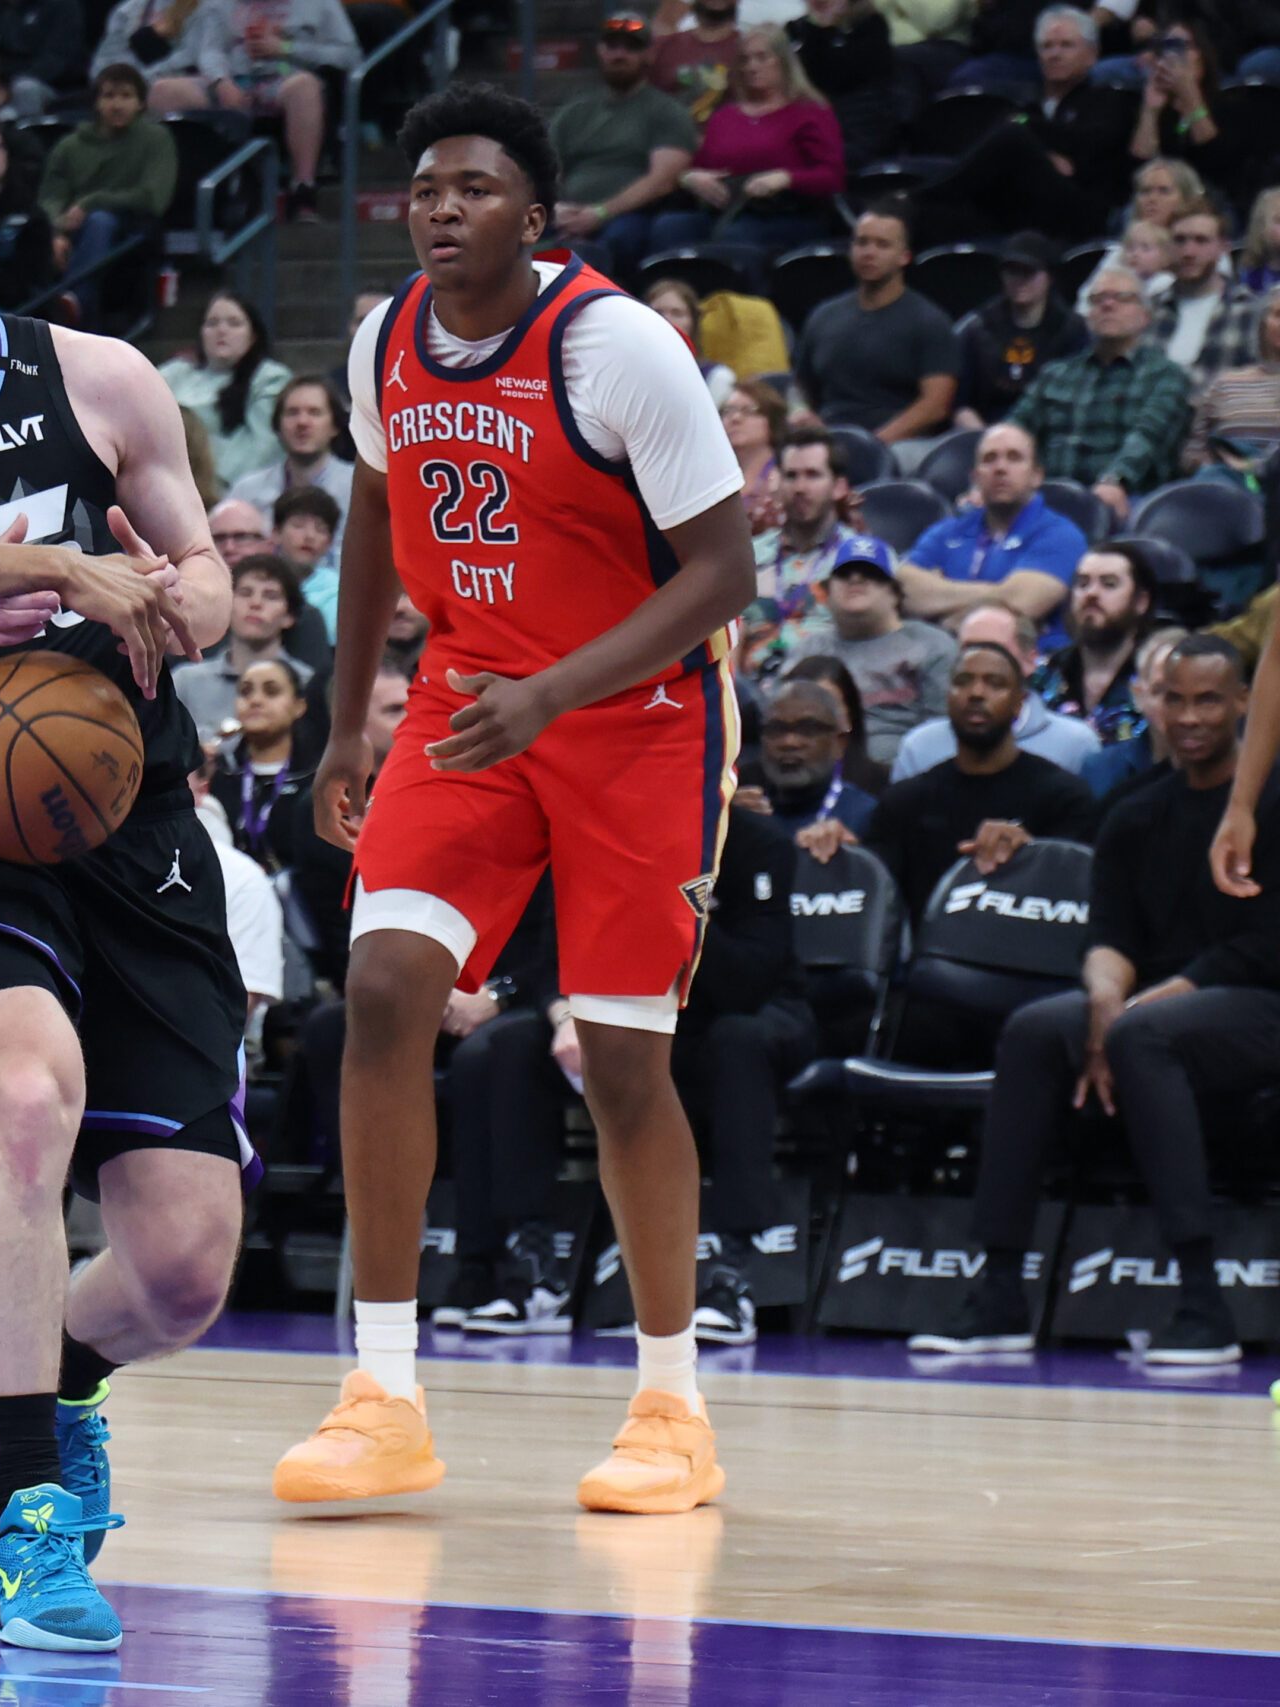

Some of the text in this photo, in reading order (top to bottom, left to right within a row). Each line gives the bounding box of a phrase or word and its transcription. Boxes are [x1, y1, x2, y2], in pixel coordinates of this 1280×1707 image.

[10, 359, 38, 376] FRANK
[495, 376, 548, 392] NEWAGE
[501, 389, 544, 400] PRODUCTS
[389, 402, 535, 463] CRESCENT
[420, 459, 519, 544] 22
[451, 559, 515, 604] CITY
[976, 890, 1090, 925] FILEVIN
[877, 1247, 1044, 1280] FILEVE
